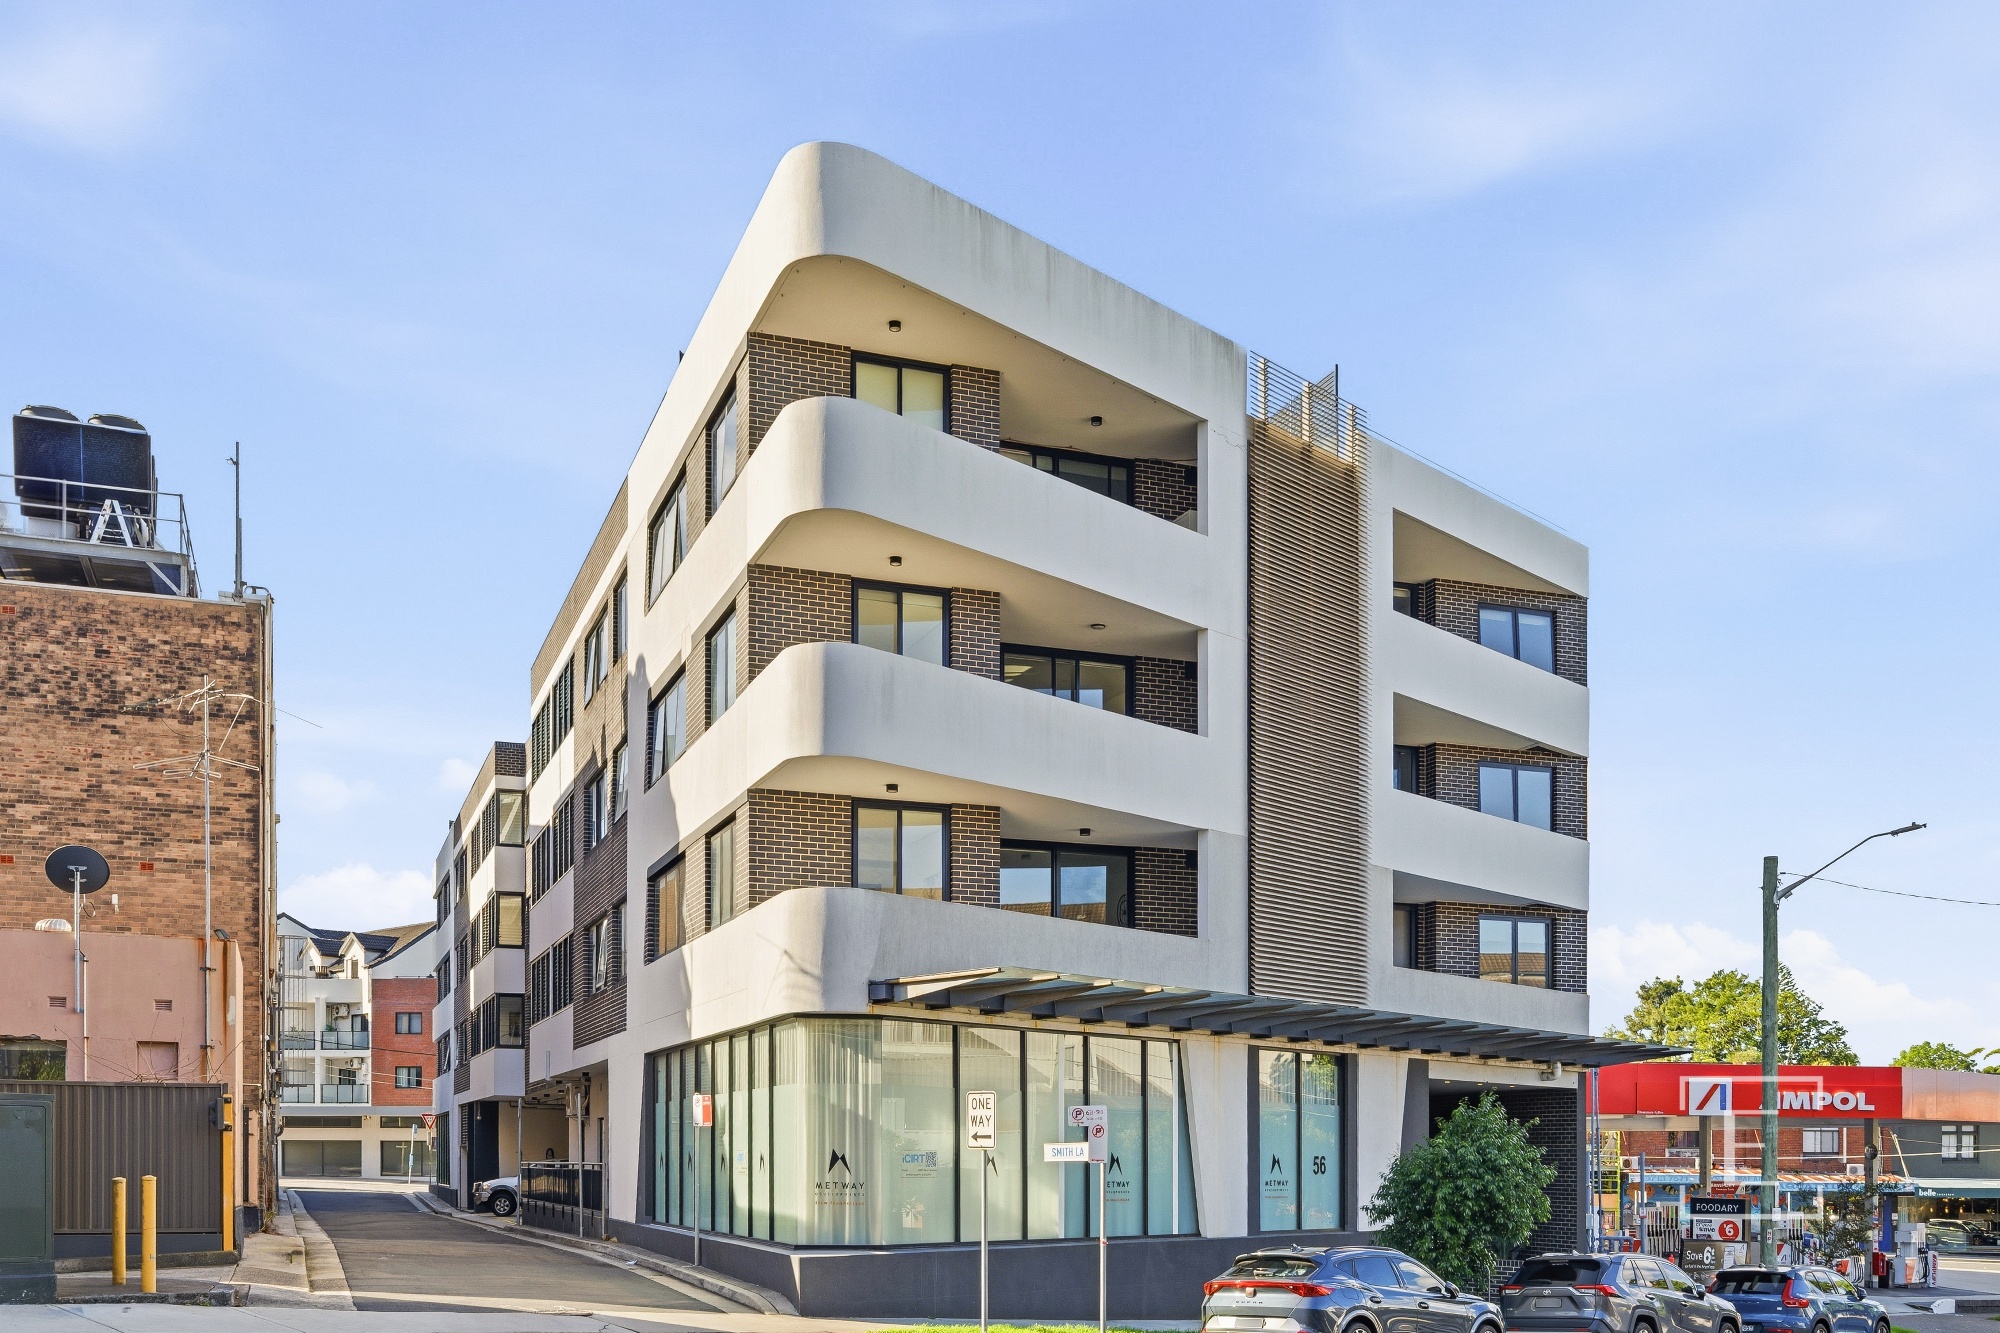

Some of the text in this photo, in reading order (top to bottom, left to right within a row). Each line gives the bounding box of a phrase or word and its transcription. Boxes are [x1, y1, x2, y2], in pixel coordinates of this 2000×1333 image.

[971, 1097, 992, 1110] ONE
[970, 1114, 992, 1127] WAY
[1051, 1147, 1085, 1158] SMITH LA
[1312, 1155, 1327, 1175] 56
[815, 1181, 865, 1190] METWAY
[1918, 1188, 1937, 1197] belle
[1696, 1203, 1739, 1212] FOODARY
[1686, 1250, 1703, 1261] Save
